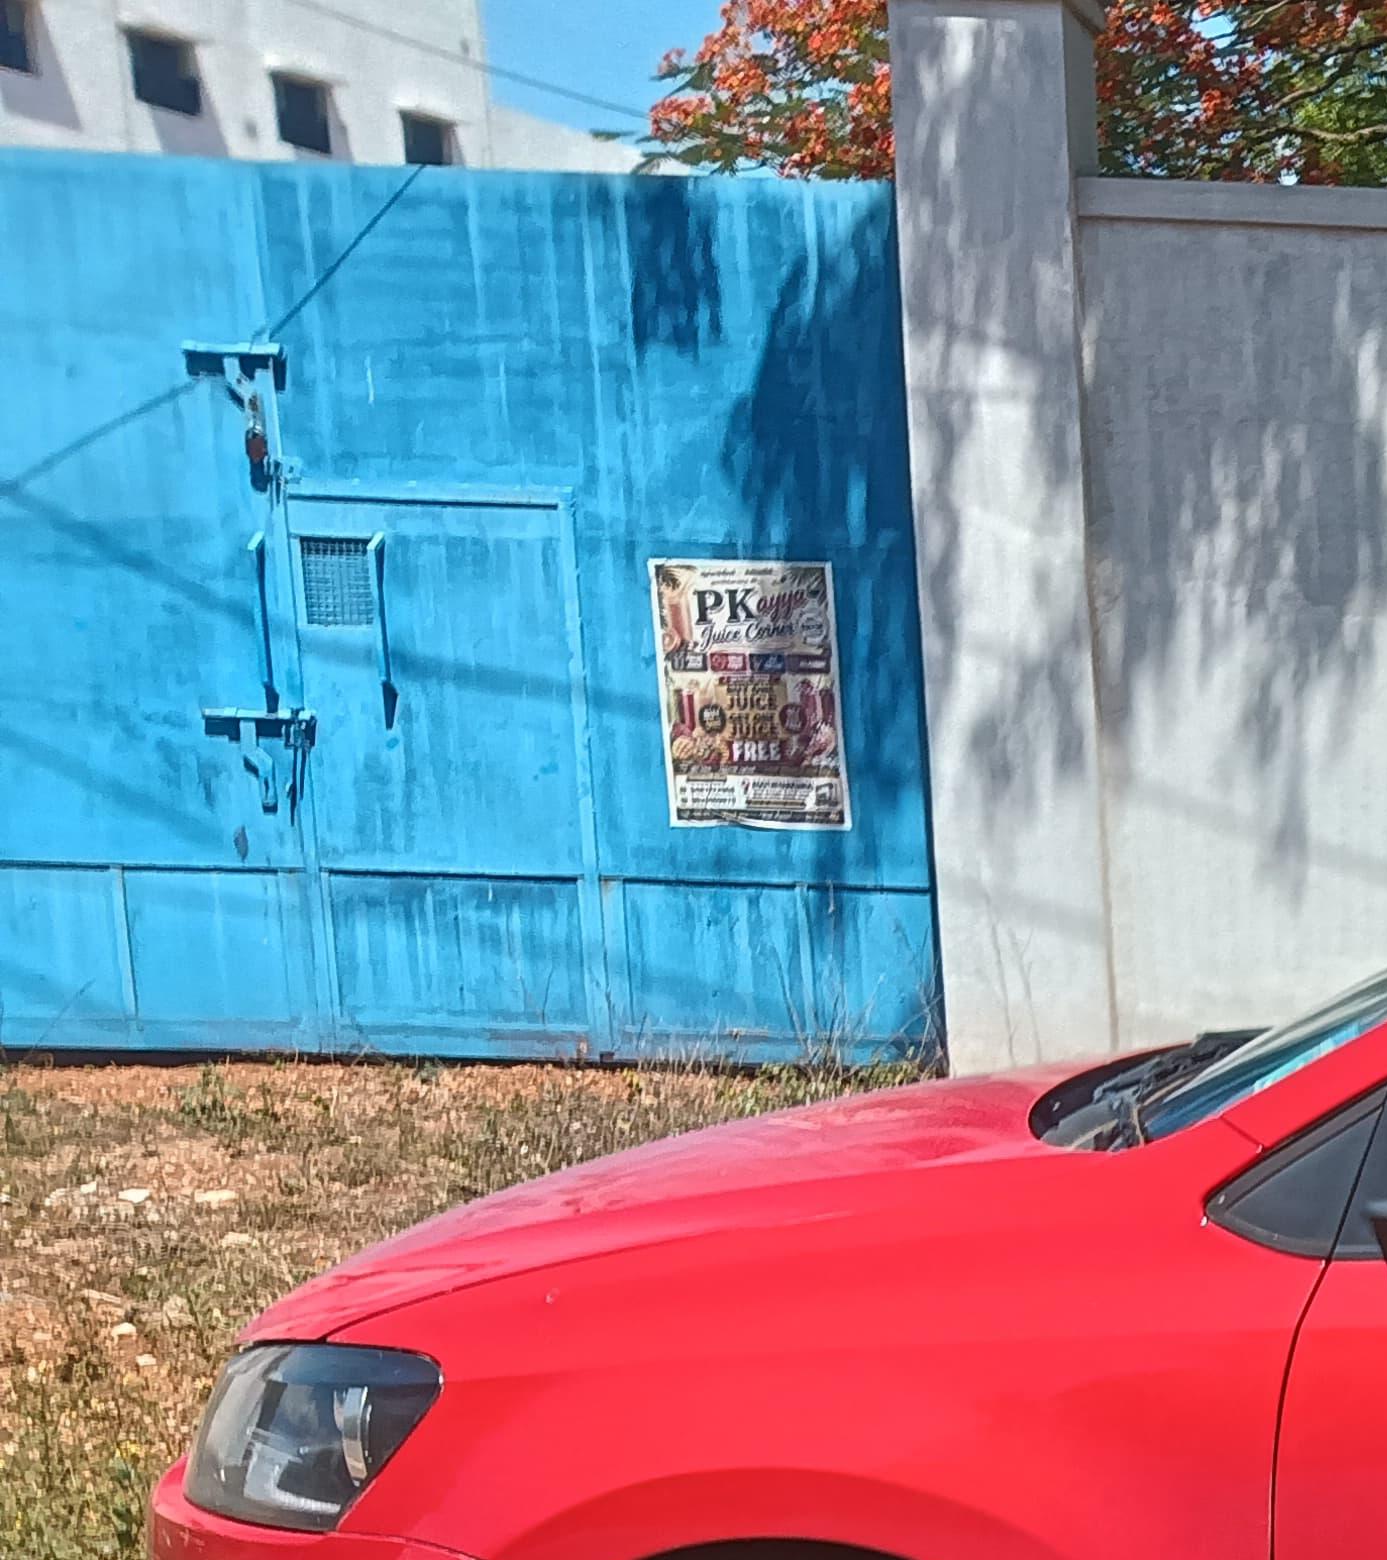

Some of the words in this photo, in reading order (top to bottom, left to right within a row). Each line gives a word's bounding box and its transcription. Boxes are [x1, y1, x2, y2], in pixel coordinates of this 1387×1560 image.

[698, 624, 742, 650] Juice
[727, 694, 777, 711] JUICE
[733, 741, 781, 762] FREE
